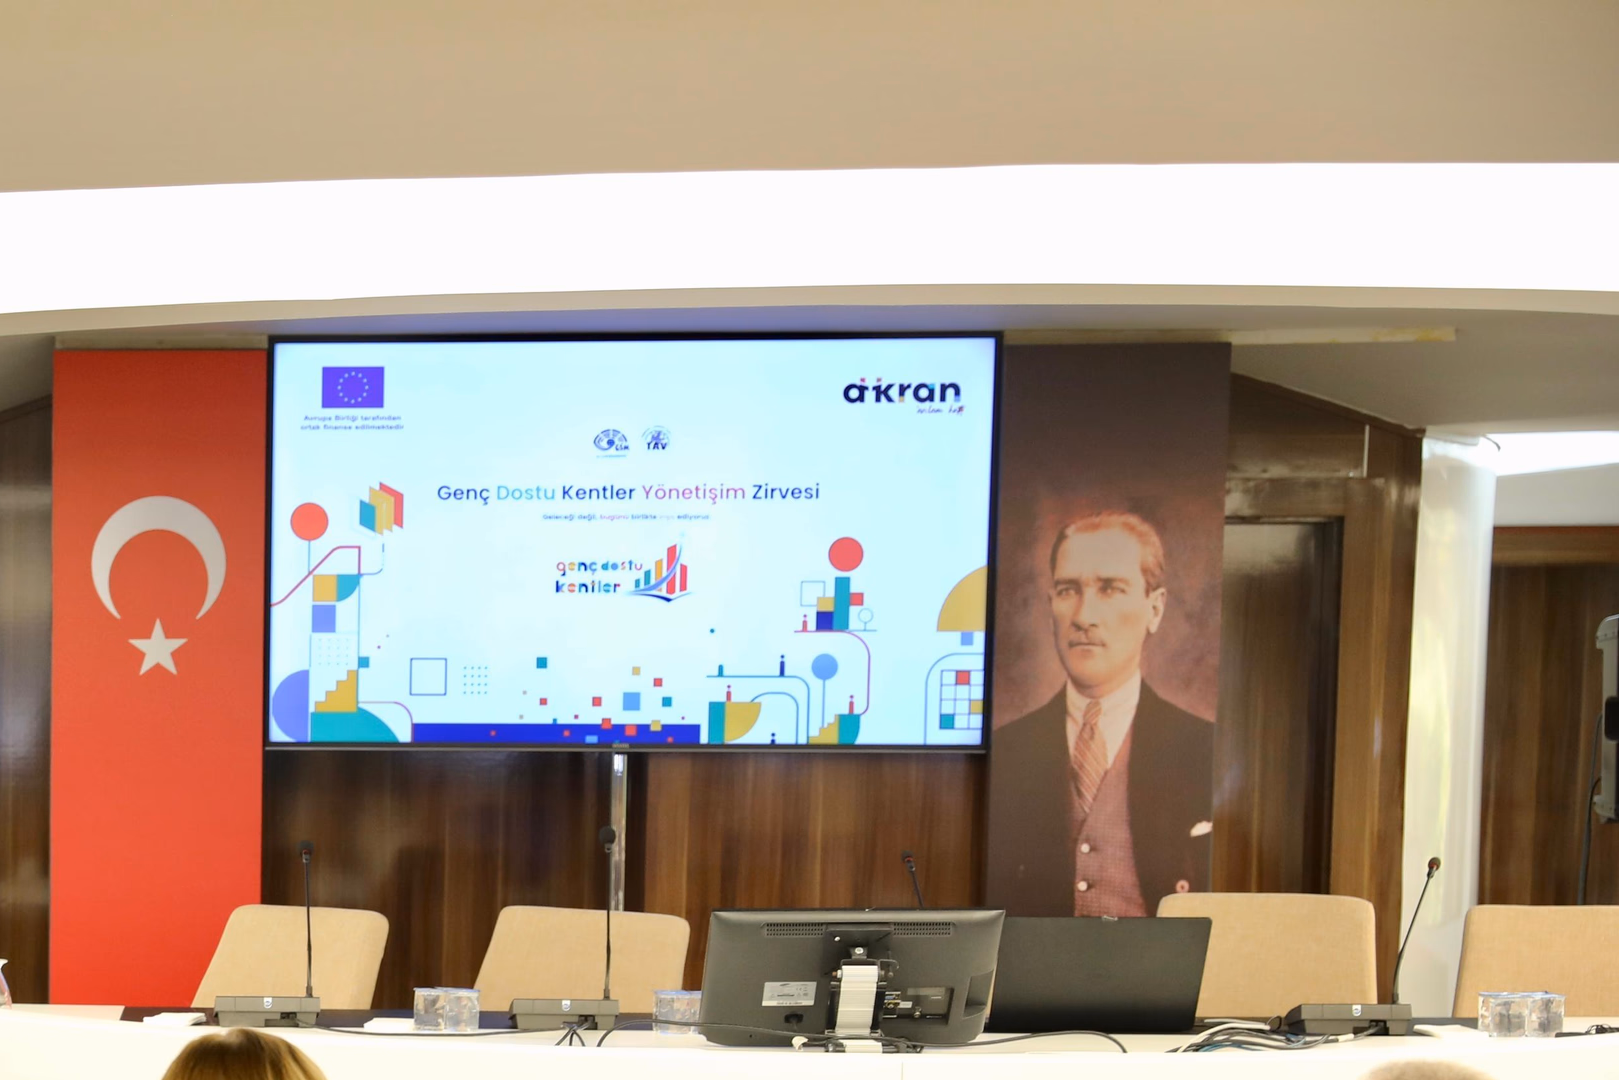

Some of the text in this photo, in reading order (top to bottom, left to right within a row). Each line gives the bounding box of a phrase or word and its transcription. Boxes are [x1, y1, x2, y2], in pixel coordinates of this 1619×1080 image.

[843, 377, 961, 404] akran
[437, 483, 820, 506] Genç Dostu Kentler Yönetişim Zirvesi
[556, 560, 643, 577] genç dostu
[555, 580, 621, 593] kentler
